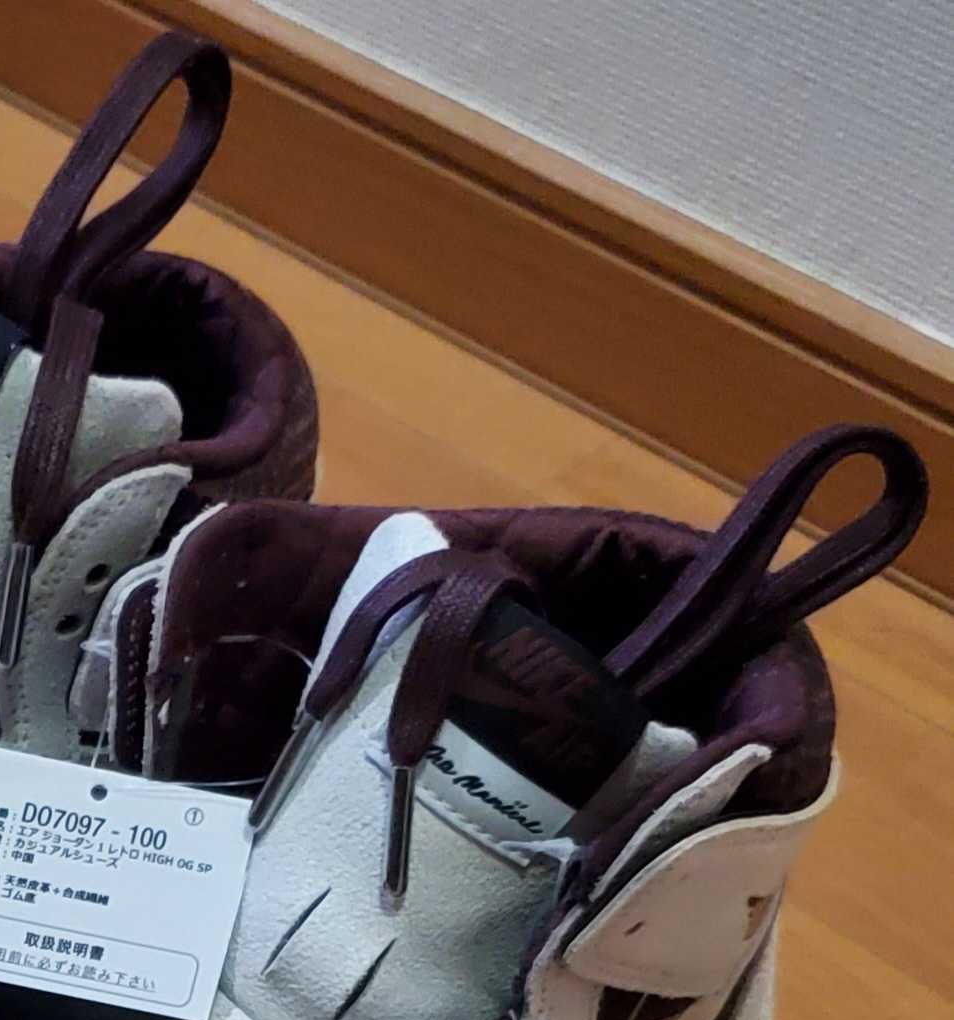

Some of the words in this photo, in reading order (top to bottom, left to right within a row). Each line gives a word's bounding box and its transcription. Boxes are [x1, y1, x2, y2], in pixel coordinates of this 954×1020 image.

[142, 852, 174, 867] HIGH
[176, 858, 195, 871] OG
[196, 862, 213, 874] SP
[23, 931, 105, 961] 取扱説明書
